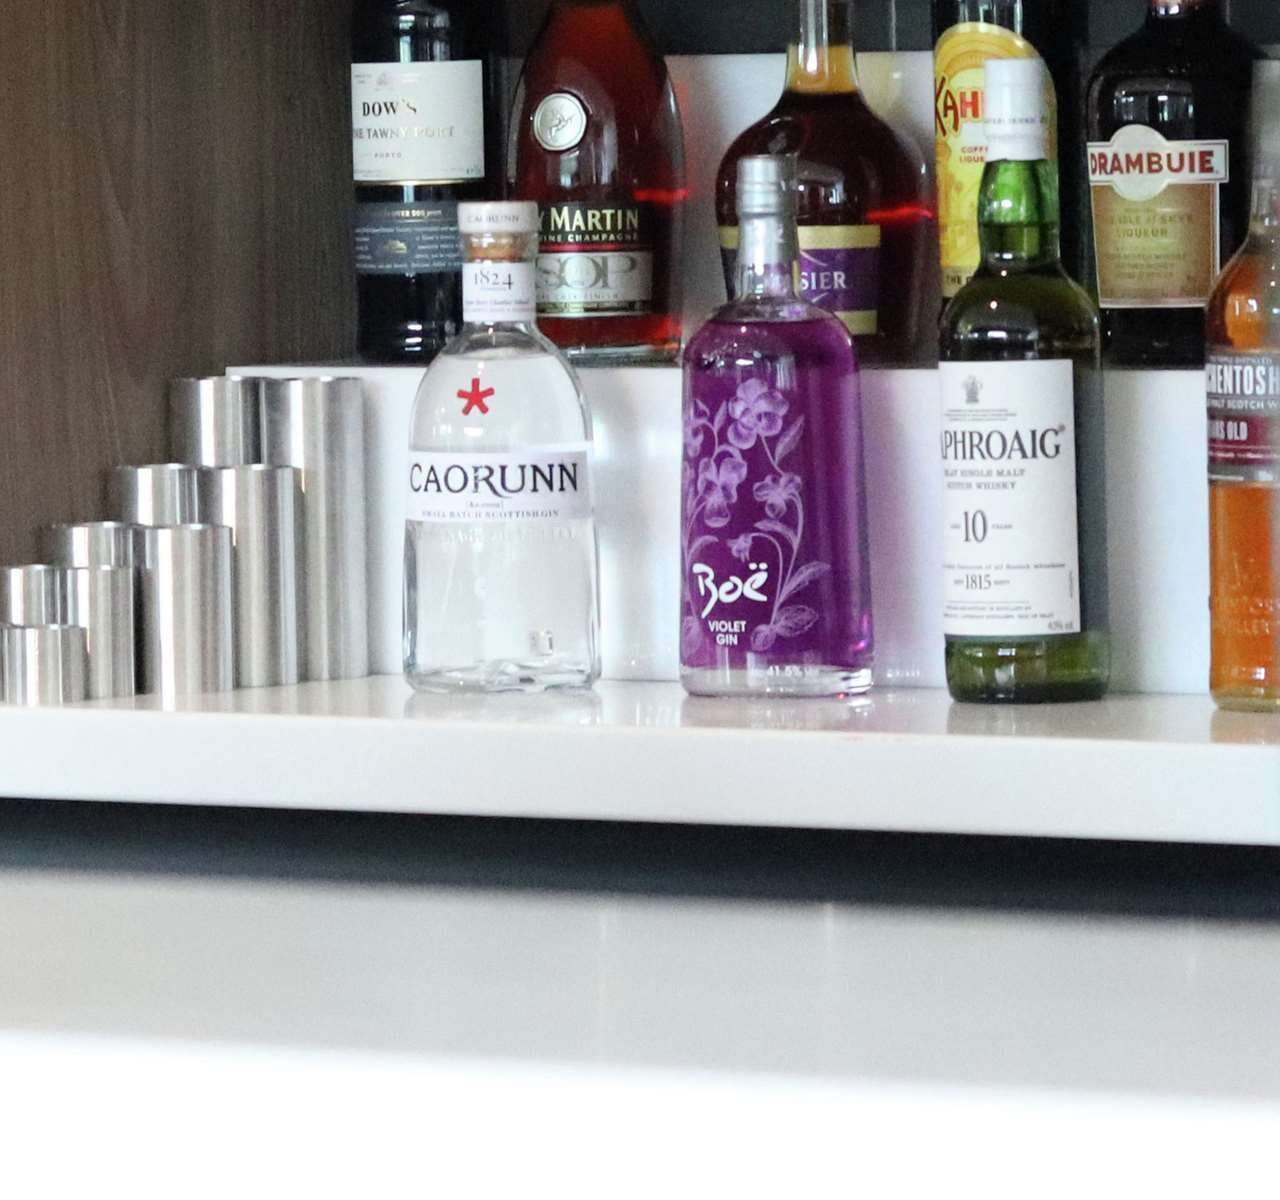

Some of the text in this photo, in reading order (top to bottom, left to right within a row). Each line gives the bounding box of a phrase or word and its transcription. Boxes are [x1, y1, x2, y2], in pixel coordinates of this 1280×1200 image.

[935, 75, 984, 137] KAH
[961, 146, 988, 154] COFF
[1090, 150, 1215, 175] DRAMBUIE
[550, 206, 639, 232] MARTIN
[543, 232, 638, 243] INE CHAMPAGNE
[474, 269, 514, 291] 1824
[535, 254, 637, 289] SOP
[1226, 420, 1249, 441] OLD
[941, 428, 1062, 461] PHROAIG
[410, 462, 578, 499] CAORUNN
[996, 468, 1026, 477] MALT
[975, 481, 1017, 490] WHISKY
[964, 510, 988, 543] 10
[692, 562, 768, 619] Boë
[964, 574, 993, 591] 1815
[708, 620, 747, 633] VIOLET
[716, 633, 738, 646] GIN
